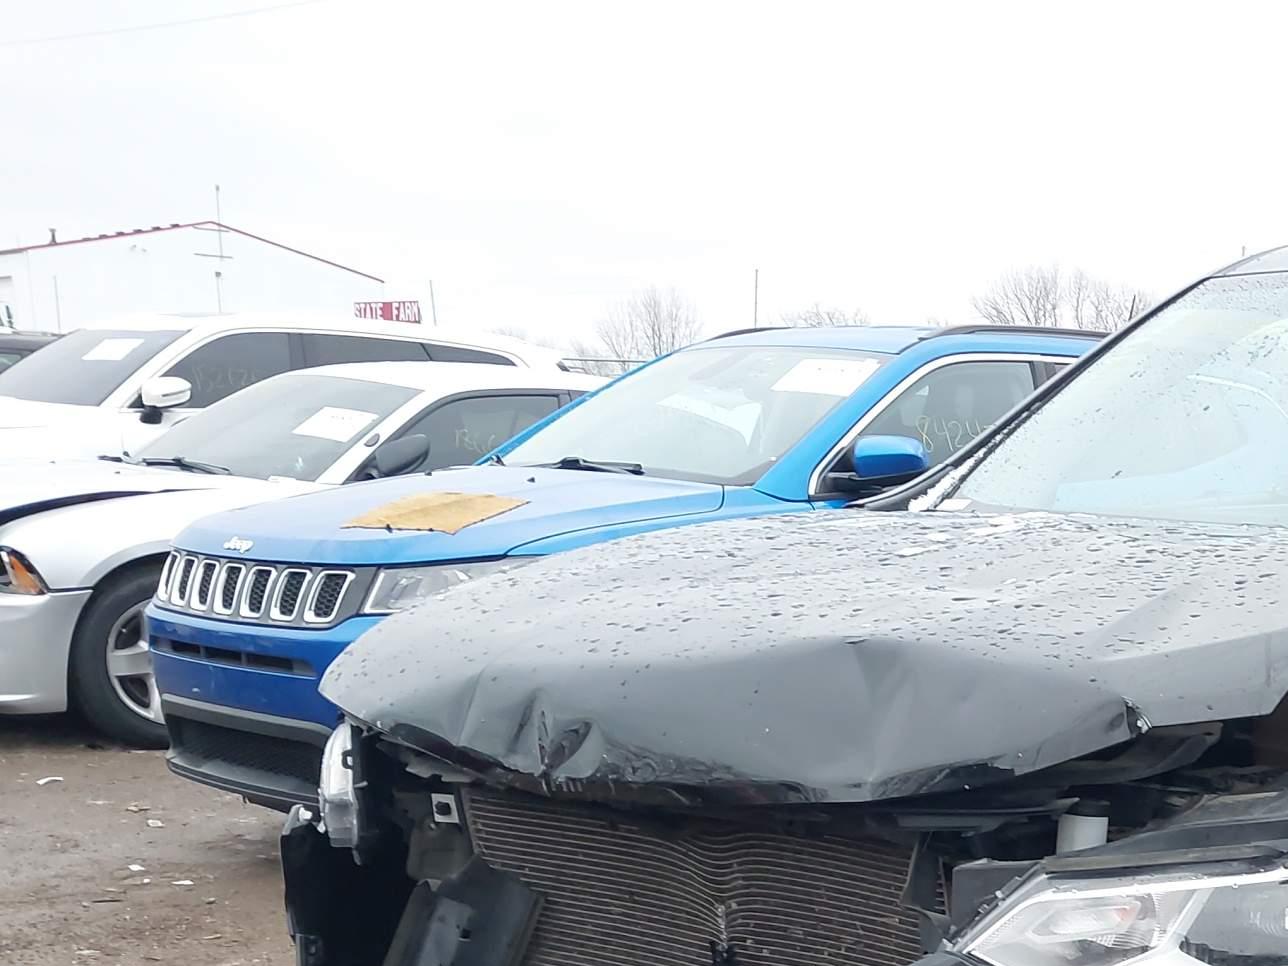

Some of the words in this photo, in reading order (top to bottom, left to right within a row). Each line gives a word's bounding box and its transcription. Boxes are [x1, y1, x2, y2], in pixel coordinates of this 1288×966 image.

[354, 302, 384, 321] STATE
[391, 301, 419, 322] FARM
[223, 535, 255, 555] Jeep
